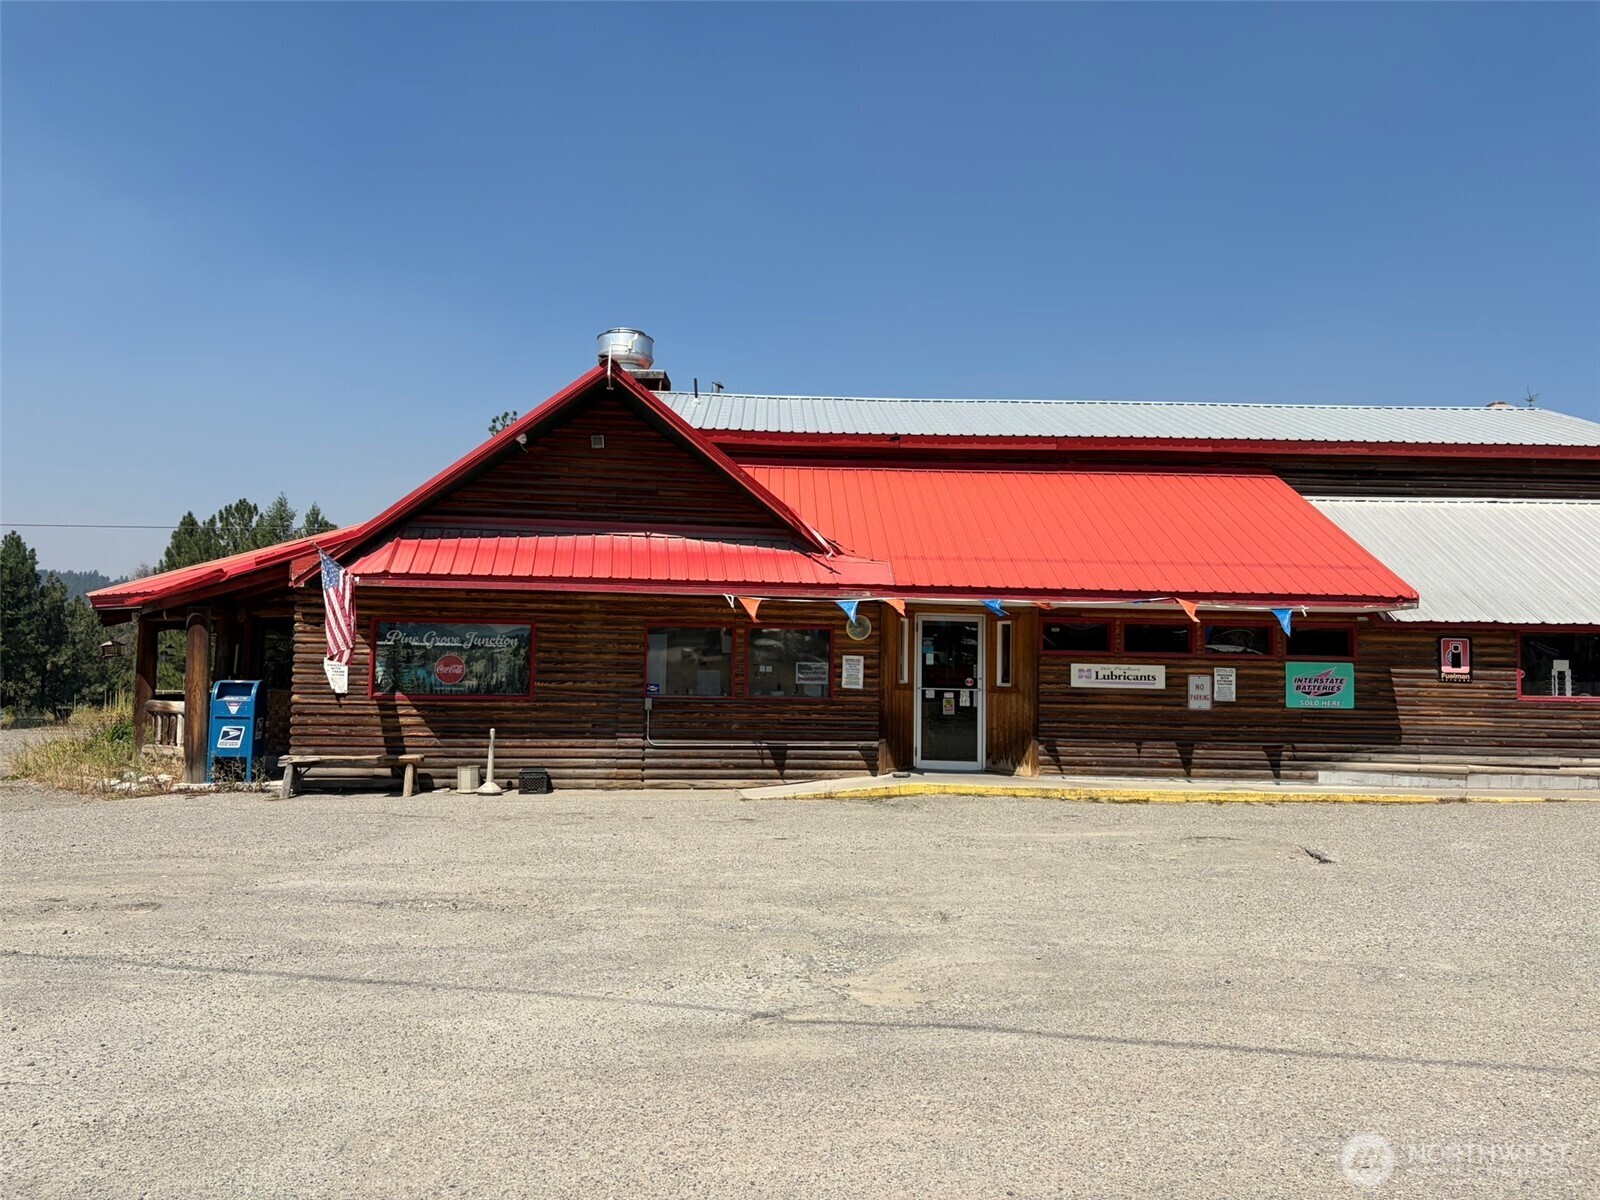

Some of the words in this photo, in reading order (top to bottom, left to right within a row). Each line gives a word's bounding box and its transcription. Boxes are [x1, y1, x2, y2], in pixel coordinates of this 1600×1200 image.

[385, 629, 419, 645] Pine
[423, 630, 461, 649] Grove
[463, 631, 519, 649] Junction
[1094, 670, 1157, 682] Lubricants
[1441, 672, 1470, 680] Fuelman
[1293, 677, 1346, 685] INTERSTATE
[1195, 683, 1205, 691] NO
[1295, 684, 1342, 692] BATTERIES
[1190, 694, 1210, 702] PARKING
